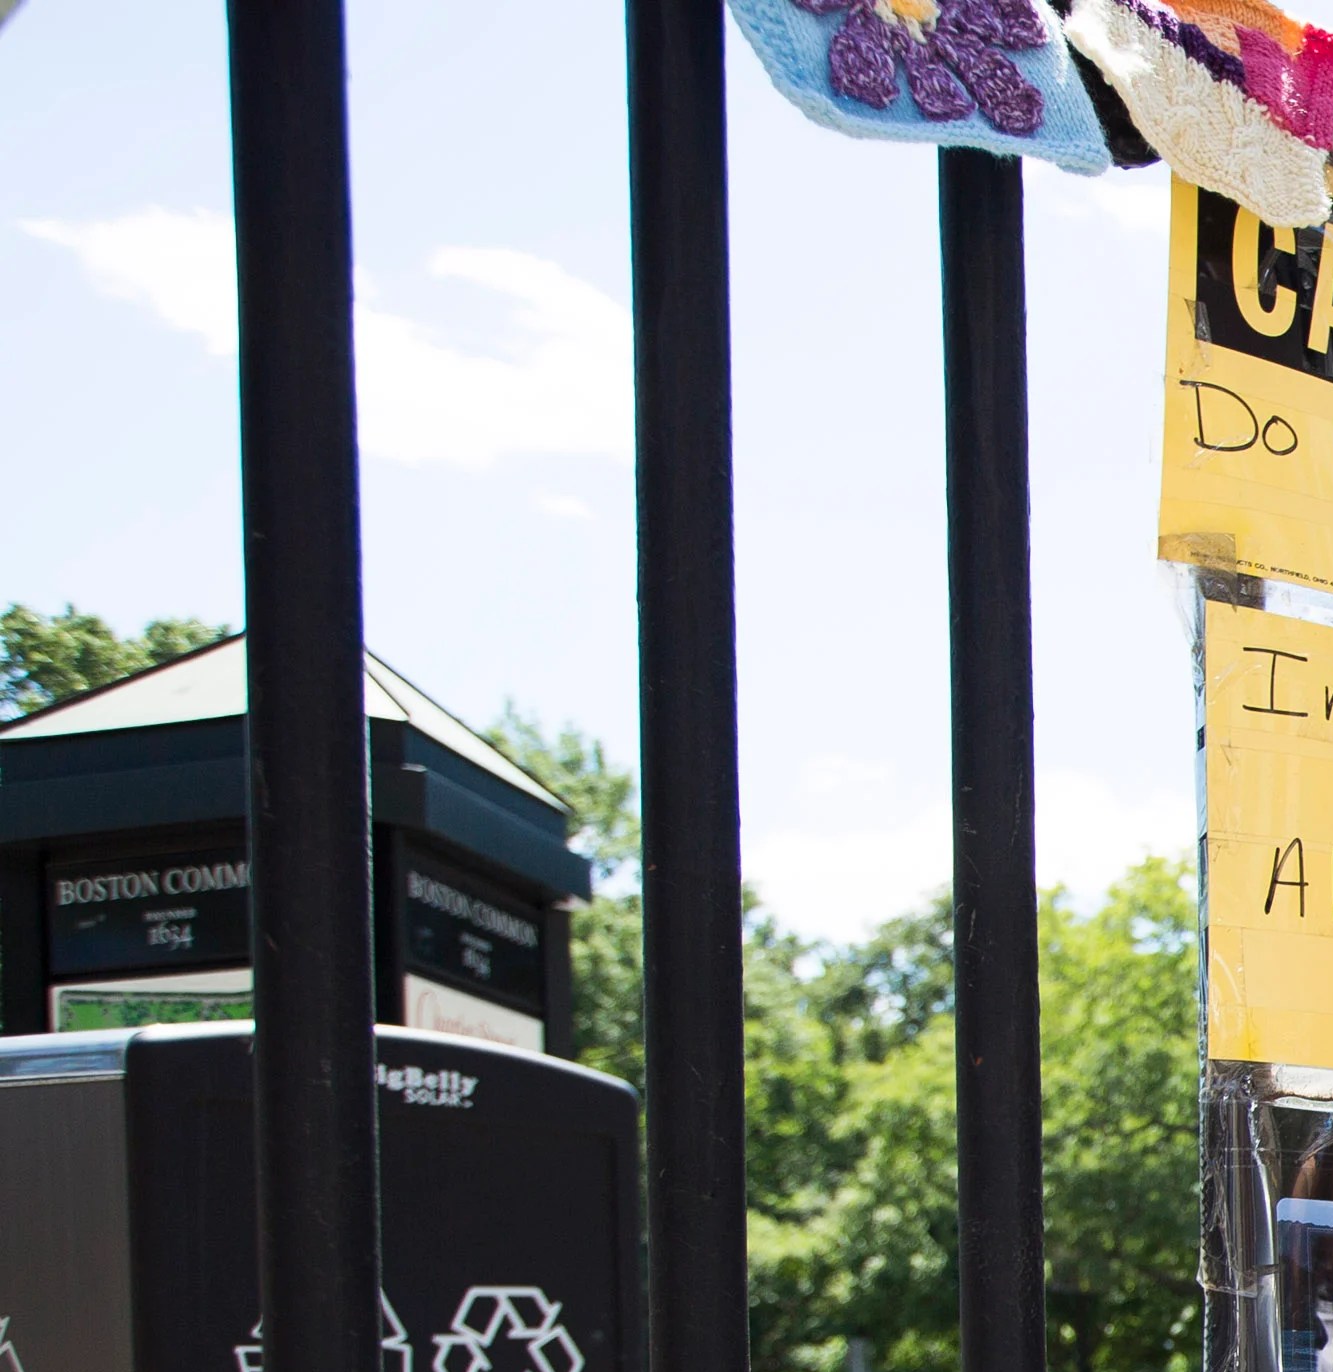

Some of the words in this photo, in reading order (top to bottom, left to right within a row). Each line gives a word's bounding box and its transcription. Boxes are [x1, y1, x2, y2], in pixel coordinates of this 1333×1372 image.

[56, 871, 160, 906] BOSTON
[161, 861, 251, 895] COMM
[407, 870, 471, 919] BOSTON
[470, 900, 539, 948] COMMON
[375, 1063, 479, 1097] igBelly
